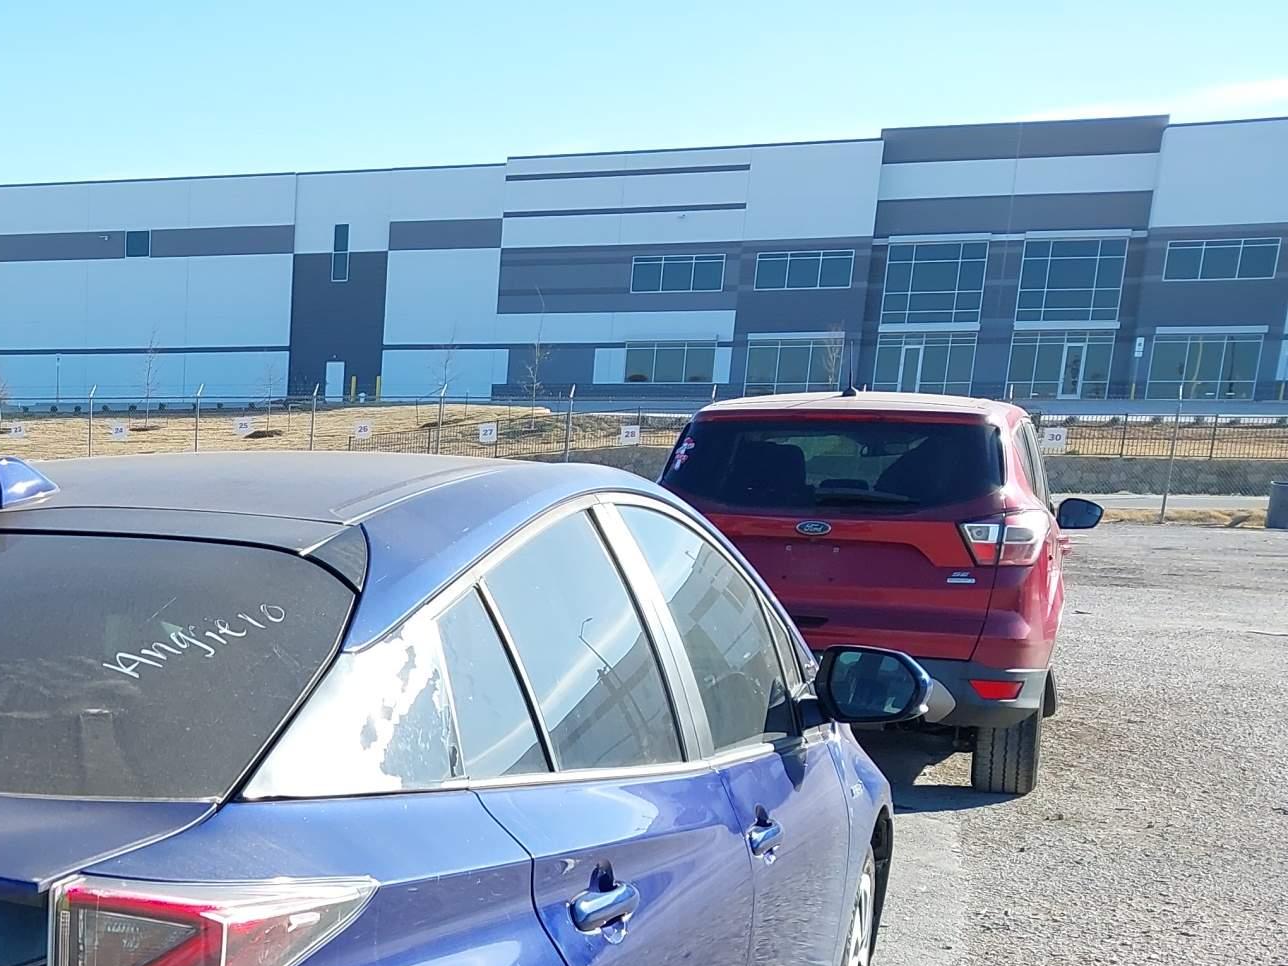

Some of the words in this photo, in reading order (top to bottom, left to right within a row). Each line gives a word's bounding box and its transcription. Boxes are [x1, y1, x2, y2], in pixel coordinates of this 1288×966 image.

[358, 425, 368, 433] 26
[624, 430, 636, 438] 28
[1048, 433, 1062, 441] 30
